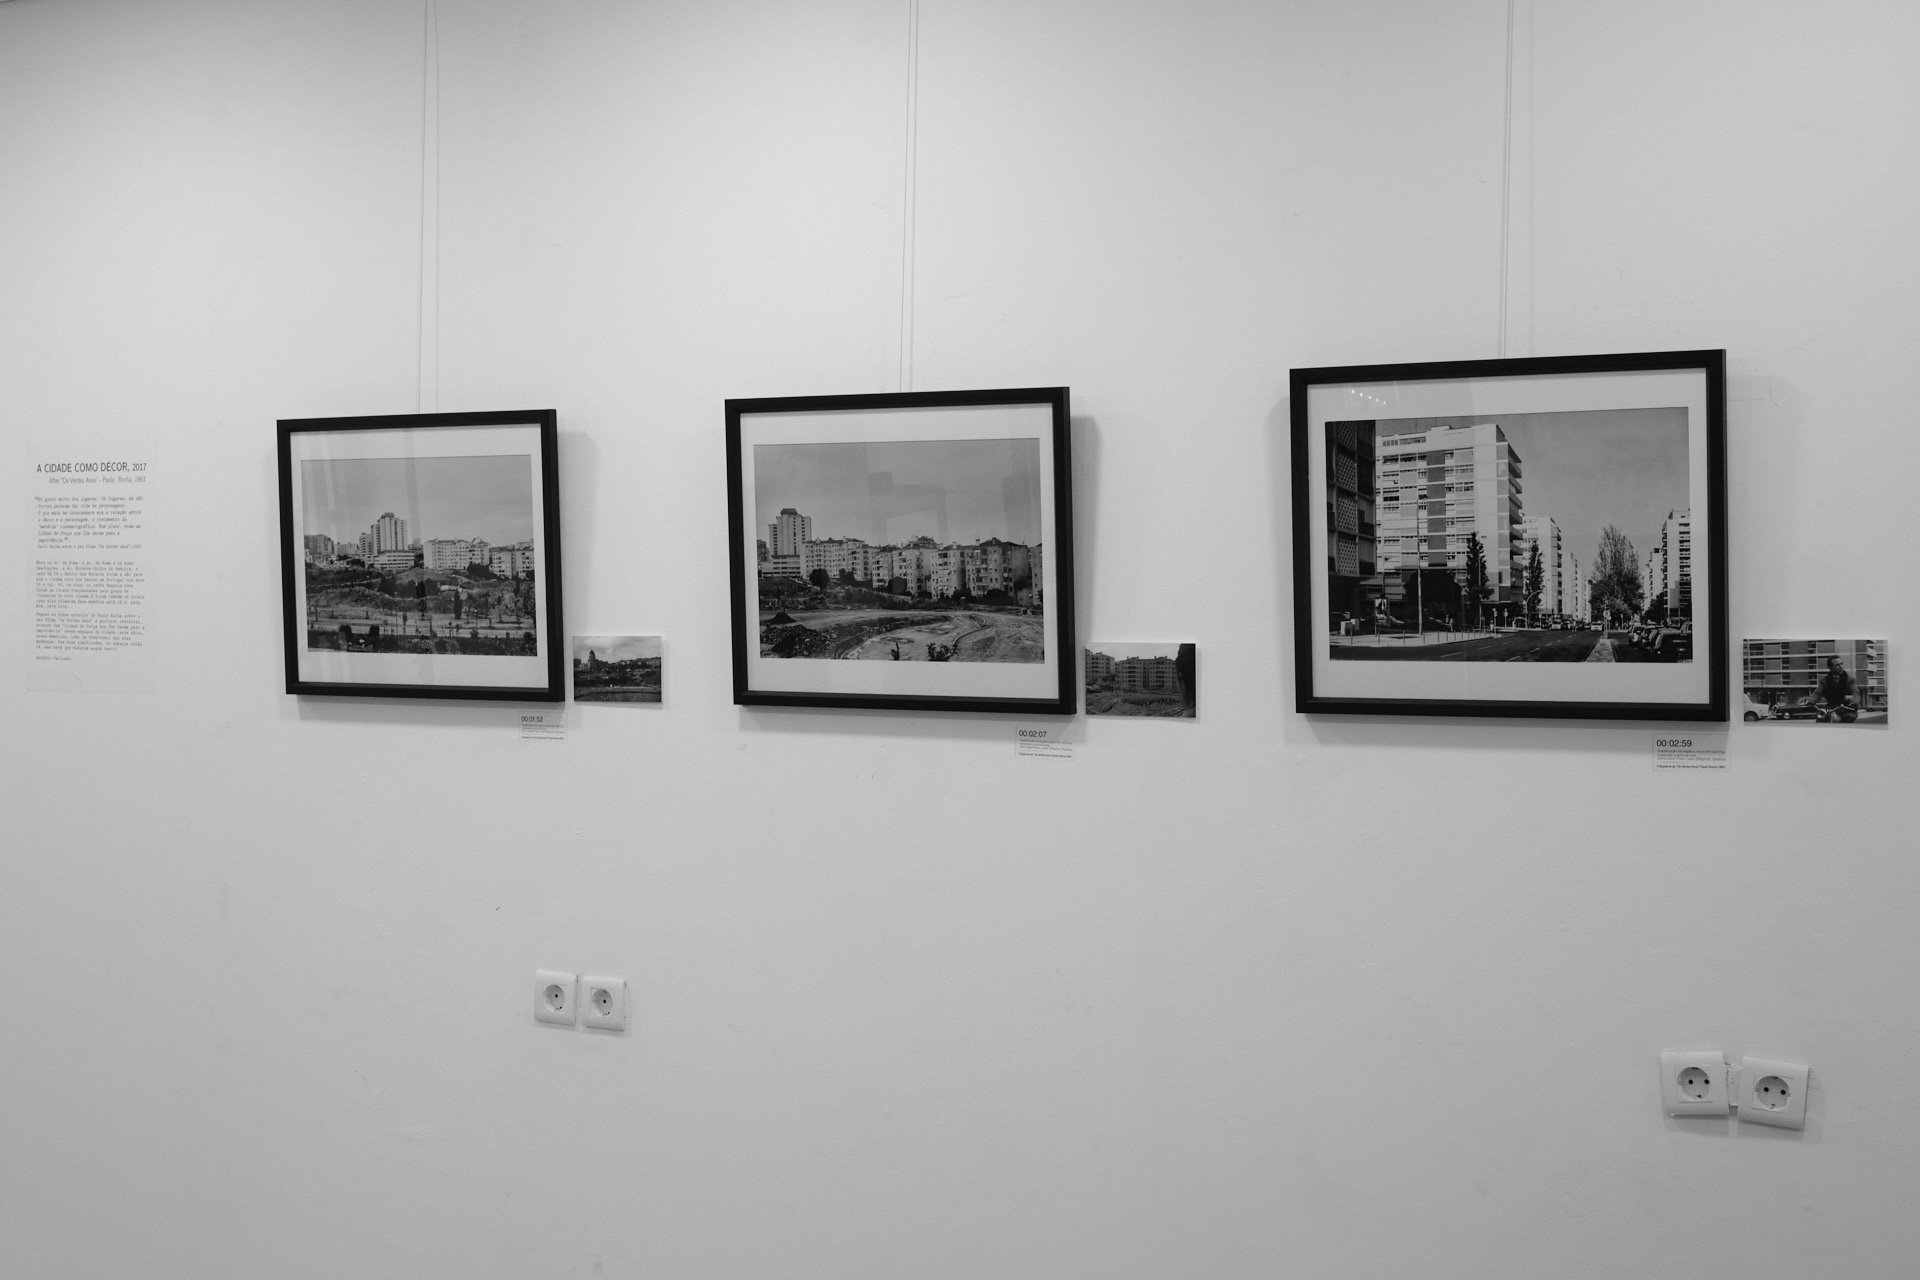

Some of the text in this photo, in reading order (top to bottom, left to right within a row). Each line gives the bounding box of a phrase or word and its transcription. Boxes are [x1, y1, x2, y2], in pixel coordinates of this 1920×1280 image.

[36, 461, 147, 473] A CIDADE COMO DÉCOR, 2017
